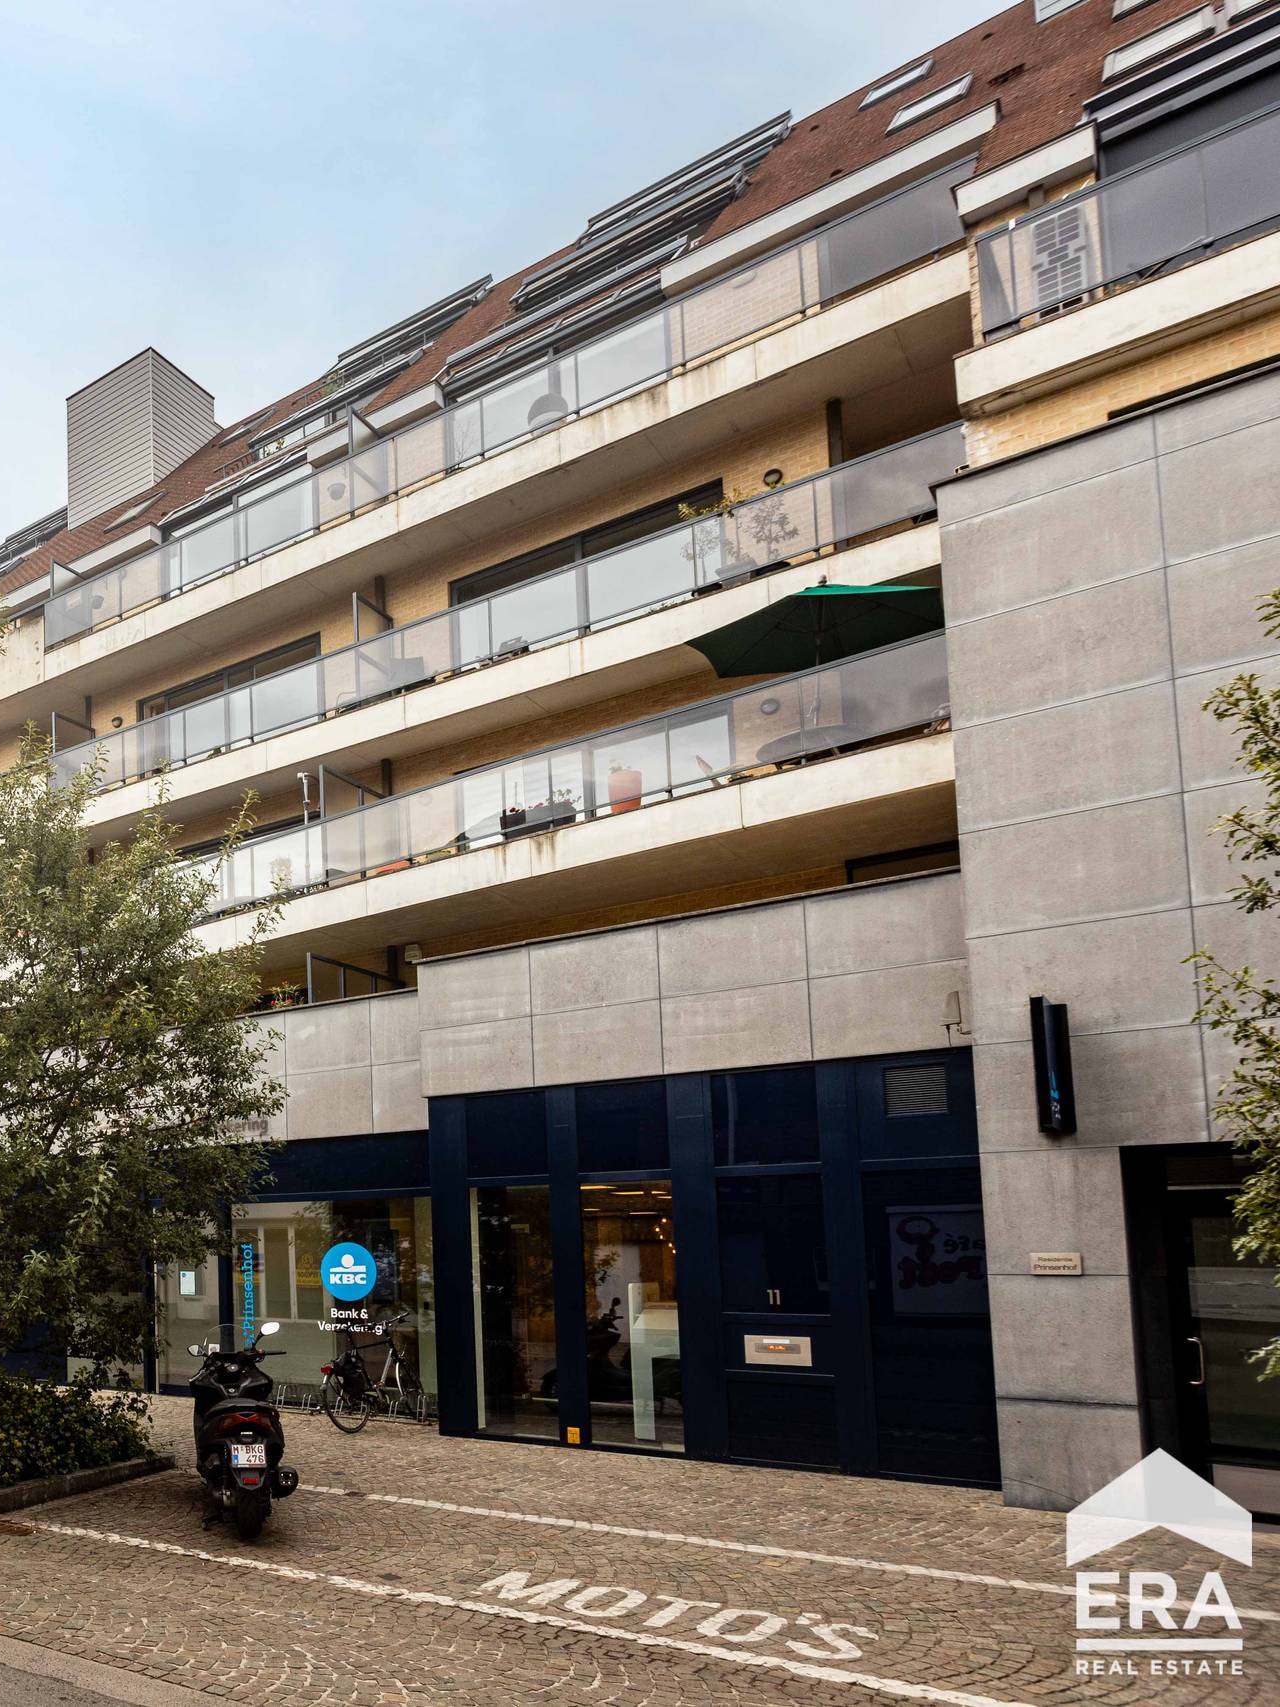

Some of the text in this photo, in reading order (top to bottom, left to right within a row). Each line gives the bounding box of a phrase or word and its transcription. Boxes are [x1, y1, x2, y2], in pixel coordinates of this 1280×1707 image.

[241, 1242, 255, 1330] Prinsenhof
[329, 1273, 367, 1285] KBC
[766, 1289, 781, 1305] 11
[330, 1308, 369, 1319] Bank &
[246, 1455, 264, 1464] 476
[471, 1571, 880, 1659] MOTO'S
